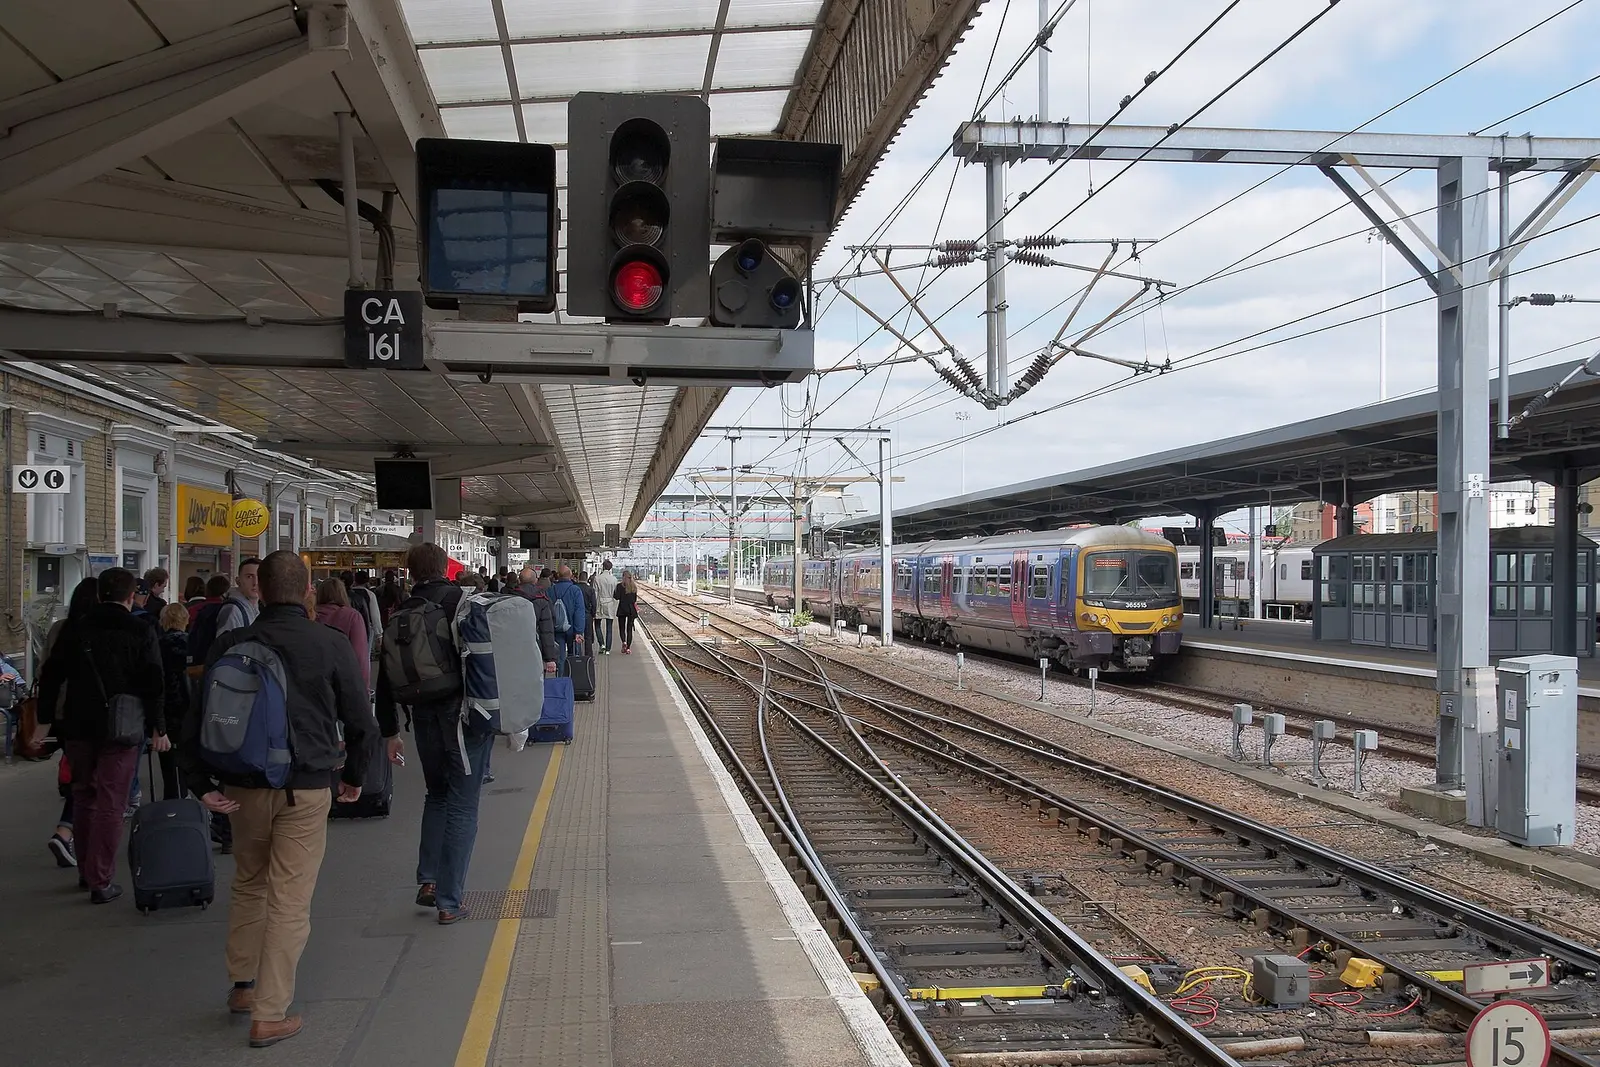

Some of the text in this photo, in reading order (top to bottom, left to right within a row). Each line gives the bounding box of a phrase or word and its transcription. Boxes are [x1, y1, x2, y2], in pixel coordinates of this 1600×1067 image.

[361, 297, 405, 325] CA
[369, 333, 400, 360] 161
[340, 534, 382, 546] AMT
[1492, 1027, 1525, 1067] 15
